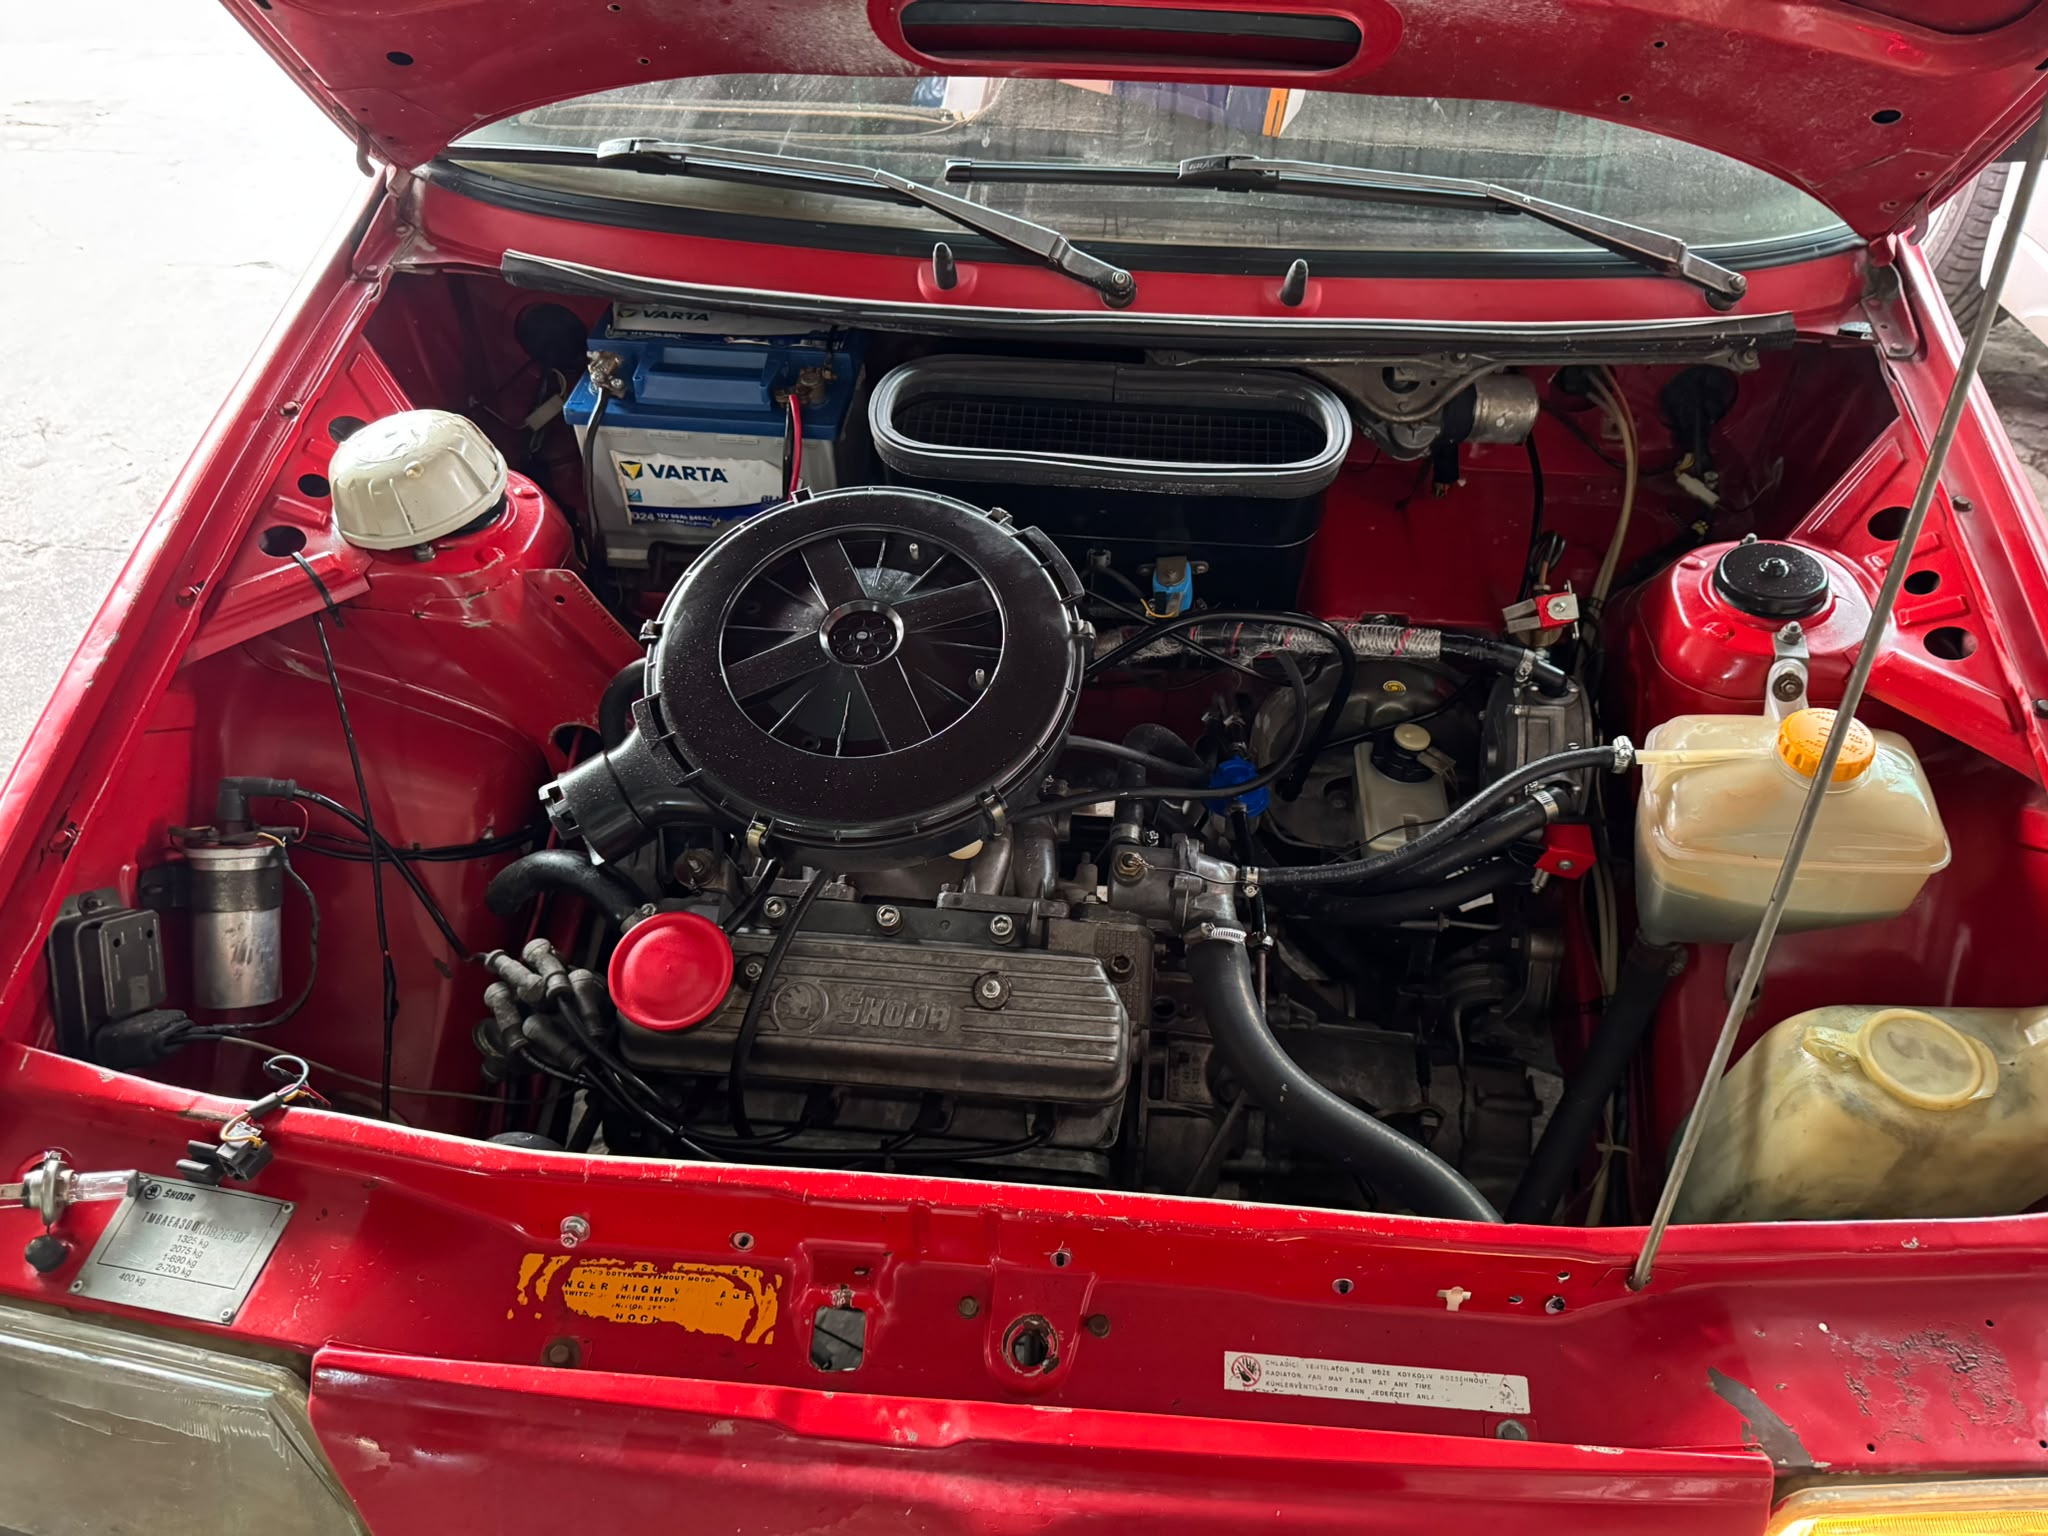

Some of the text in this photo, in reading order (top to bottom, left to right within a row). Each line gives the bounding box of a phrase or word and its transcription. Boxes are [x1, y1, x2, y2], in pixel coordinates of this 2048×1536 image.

[643, 309, 710, 321] VARTA
[647, 463, 729, 484] VARTA
[836, 991, 953, 1032] ŠKODA
[163, 1188, 196, 1202] ŠKODA
[177, 1234, 210, 1249] 1325 kg
[170, 1244, 204, 1259] 2075 kg
[186, 1258, 198, 1269] kg
[155, 1263, 192, 1279] 2-700 kg
[118, 1272, 147, 1287] 400 kg
[564, 1280, 609, 1291] NGER
[620, 1283, 662, 1294] HIGH
[649, 1295, 677, 1303] BEFOR
[1349, 1377, 1372, 1385] START
